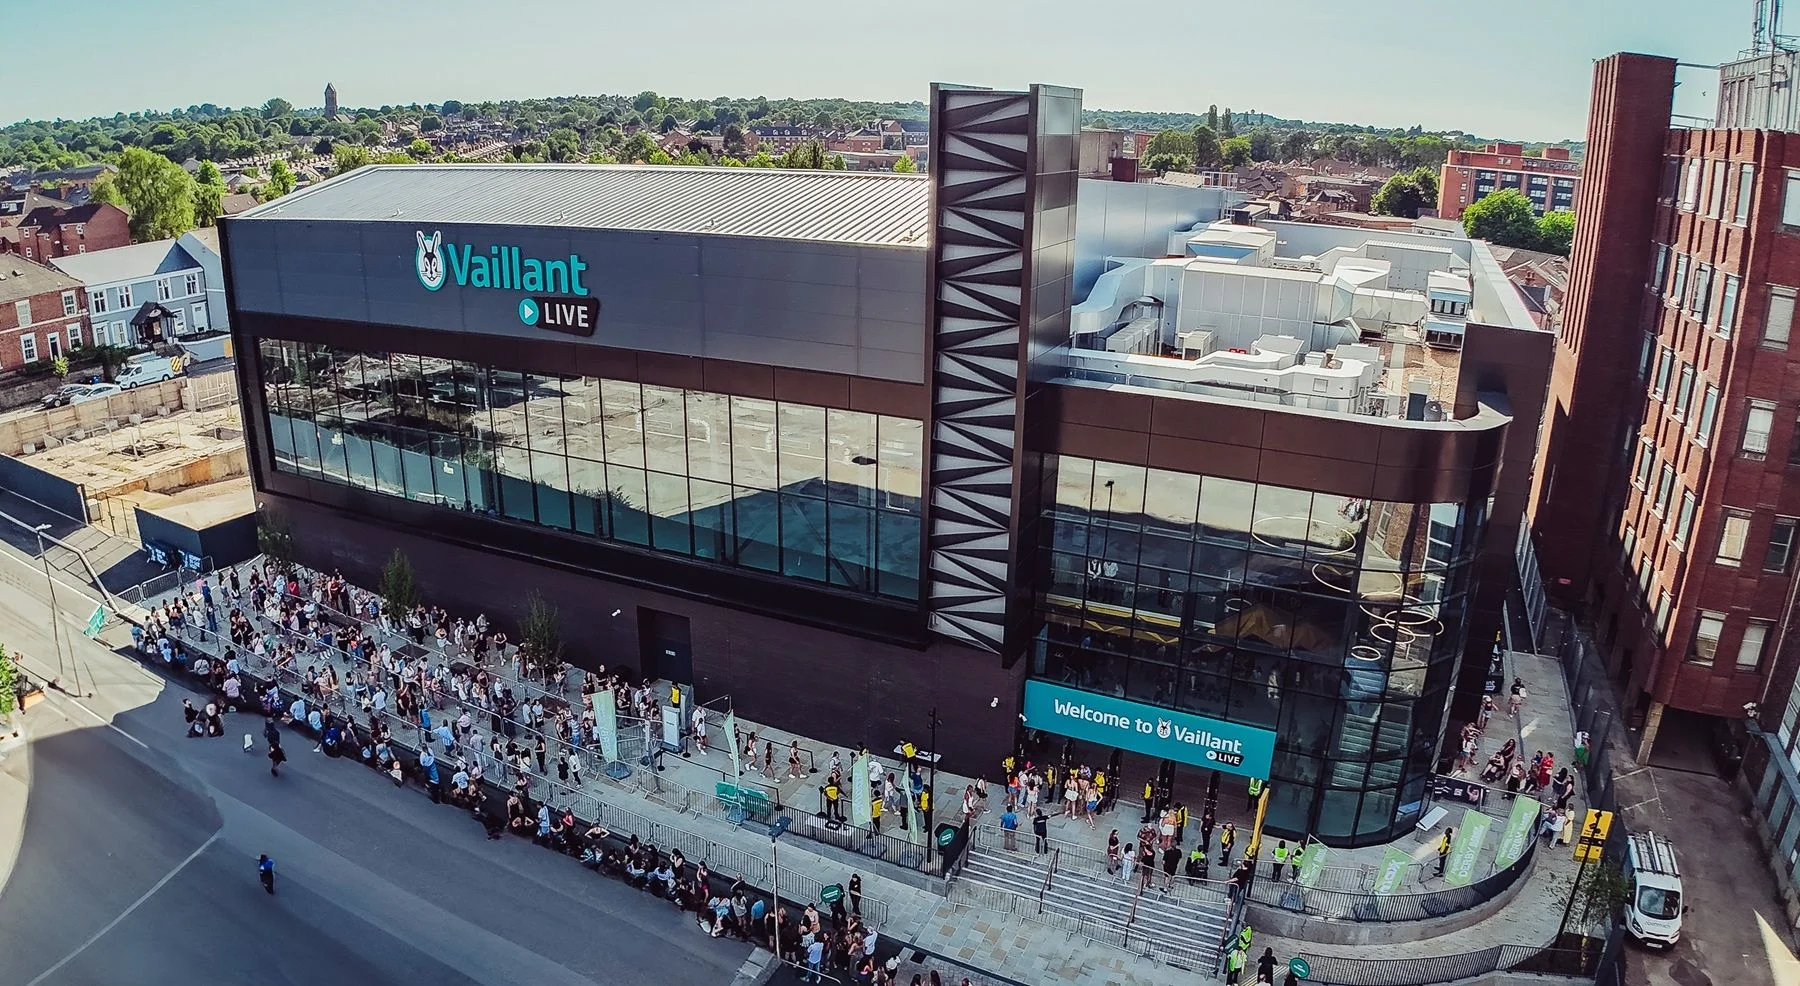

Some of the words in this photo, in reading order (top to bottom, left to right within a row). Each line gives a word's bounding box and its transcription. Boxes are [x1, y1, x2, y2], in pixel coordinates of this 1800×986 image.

[447, 243, 588, 296] Vaillant
[544, 302, 589, 328] LIVE
[1054, 699, 1130, 730] Welcome
[1135, 718, 1153, 735] to
[1174, 725, 1242, 754] Vaillant
[1217, 752, 1241, 765] LIVE
[1507, 831, 1523, 860] DERBY
[1459, 846, 1476, 877] DERBY
